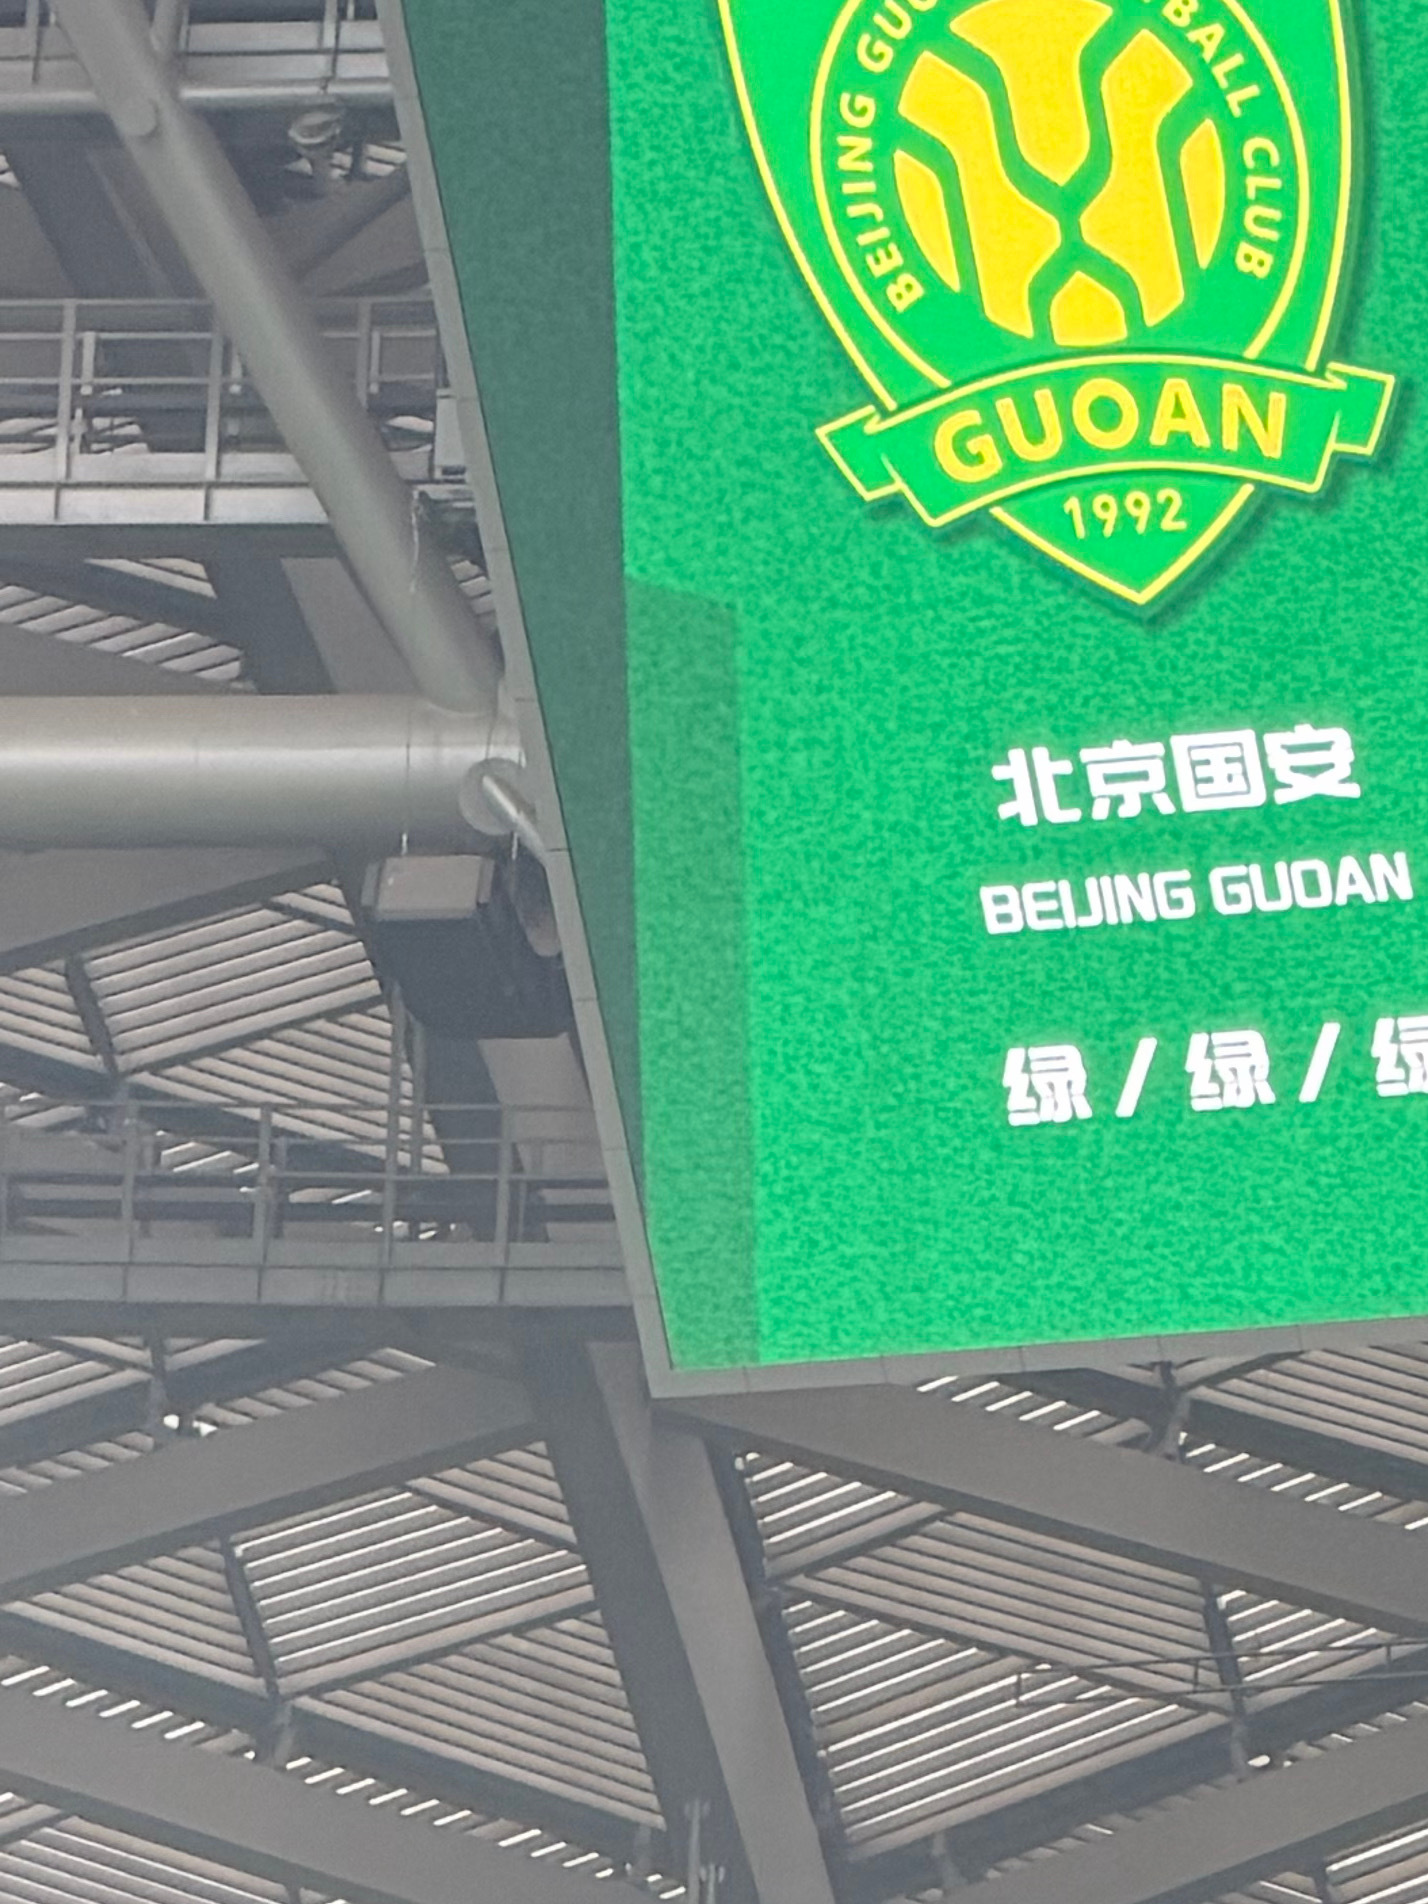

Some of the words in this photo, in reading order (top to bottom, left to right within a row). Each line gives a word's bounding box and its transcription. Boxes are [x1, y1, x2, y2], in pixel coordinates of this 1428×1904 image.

[836, 92, 925, 313] BEIJING
[1234, 136, 1283, 279] CLUB
[933, 376, 1288, 484] GUOAN
[1064, 487, 1188, 539] 1992
[990, 721, 1362, 827] 北京国安
[978, 867, 1198, 936] BEIJING
[1207, 850, 1415, 916] GUOAN
